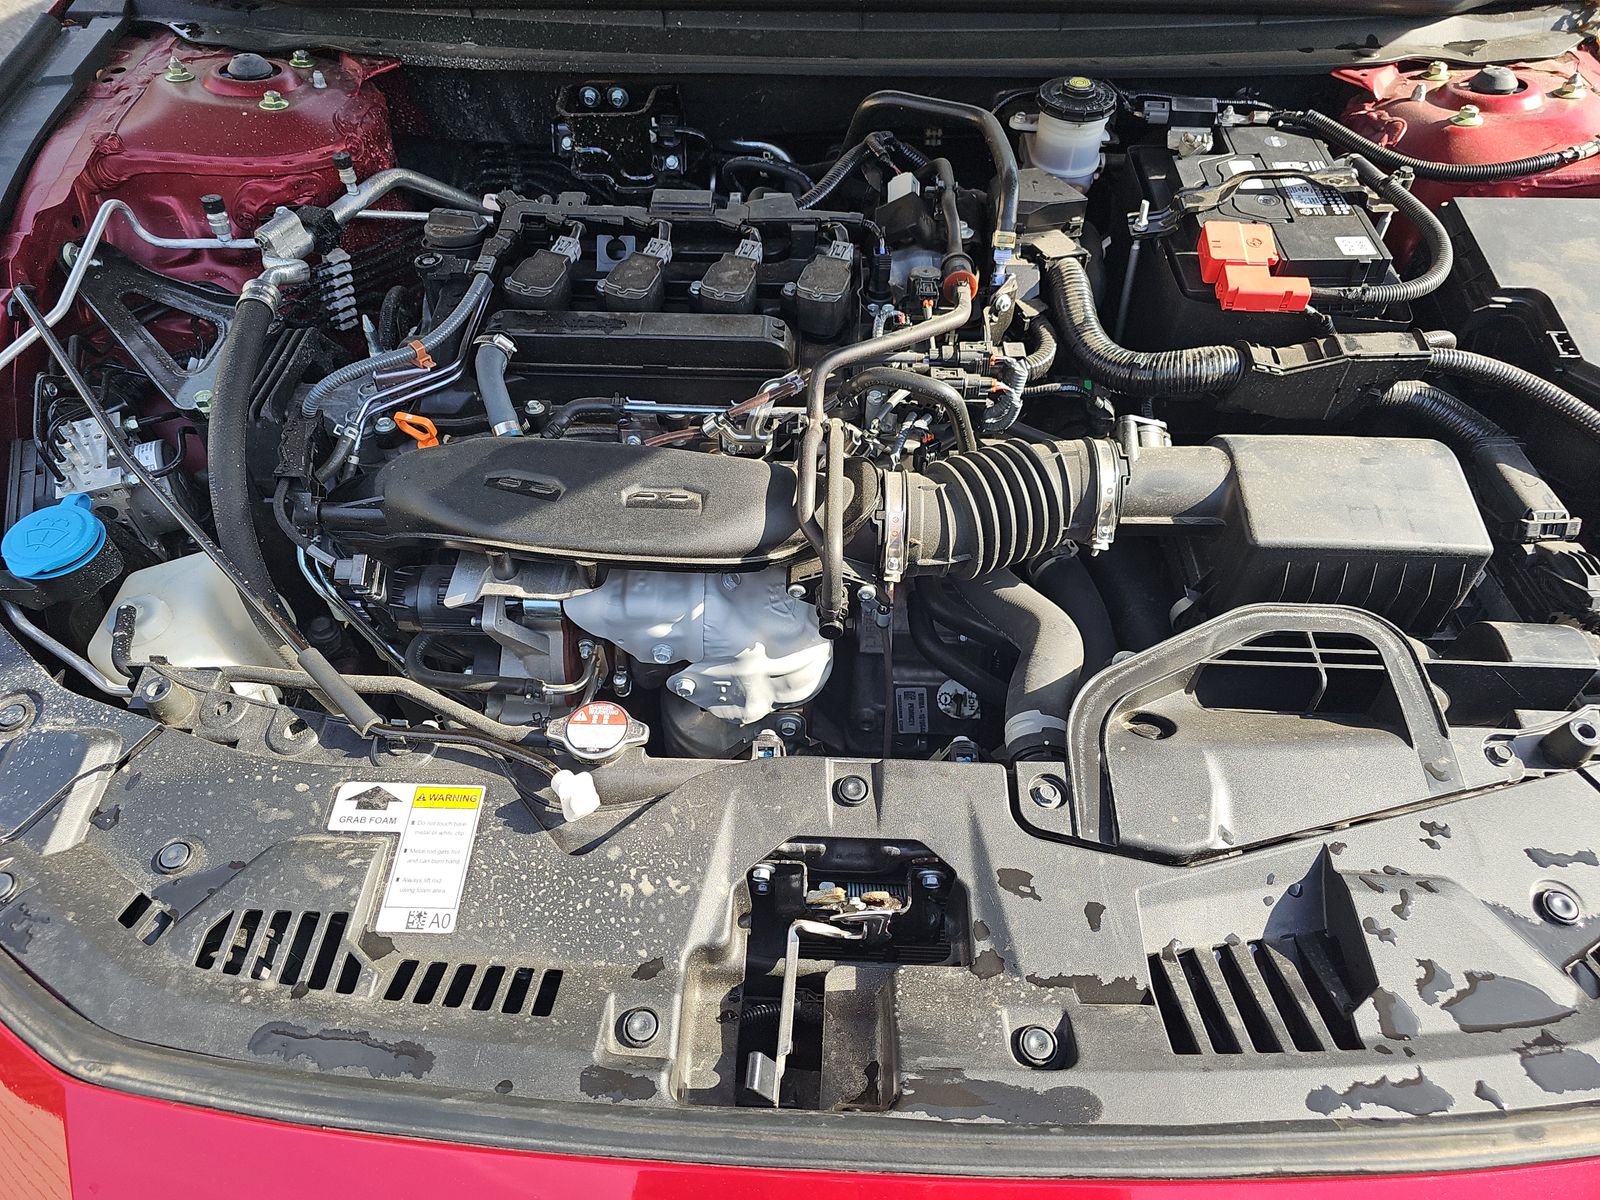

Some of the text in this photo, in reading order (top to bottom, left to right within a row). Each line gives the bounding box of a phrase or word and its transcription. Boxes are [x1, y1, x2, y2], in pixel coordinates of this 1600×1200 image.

[429, 793, 478, 803] WARNING
[338, 815, 398, 825] GRAB FOAM
[428, 912, 451, 929] A0
